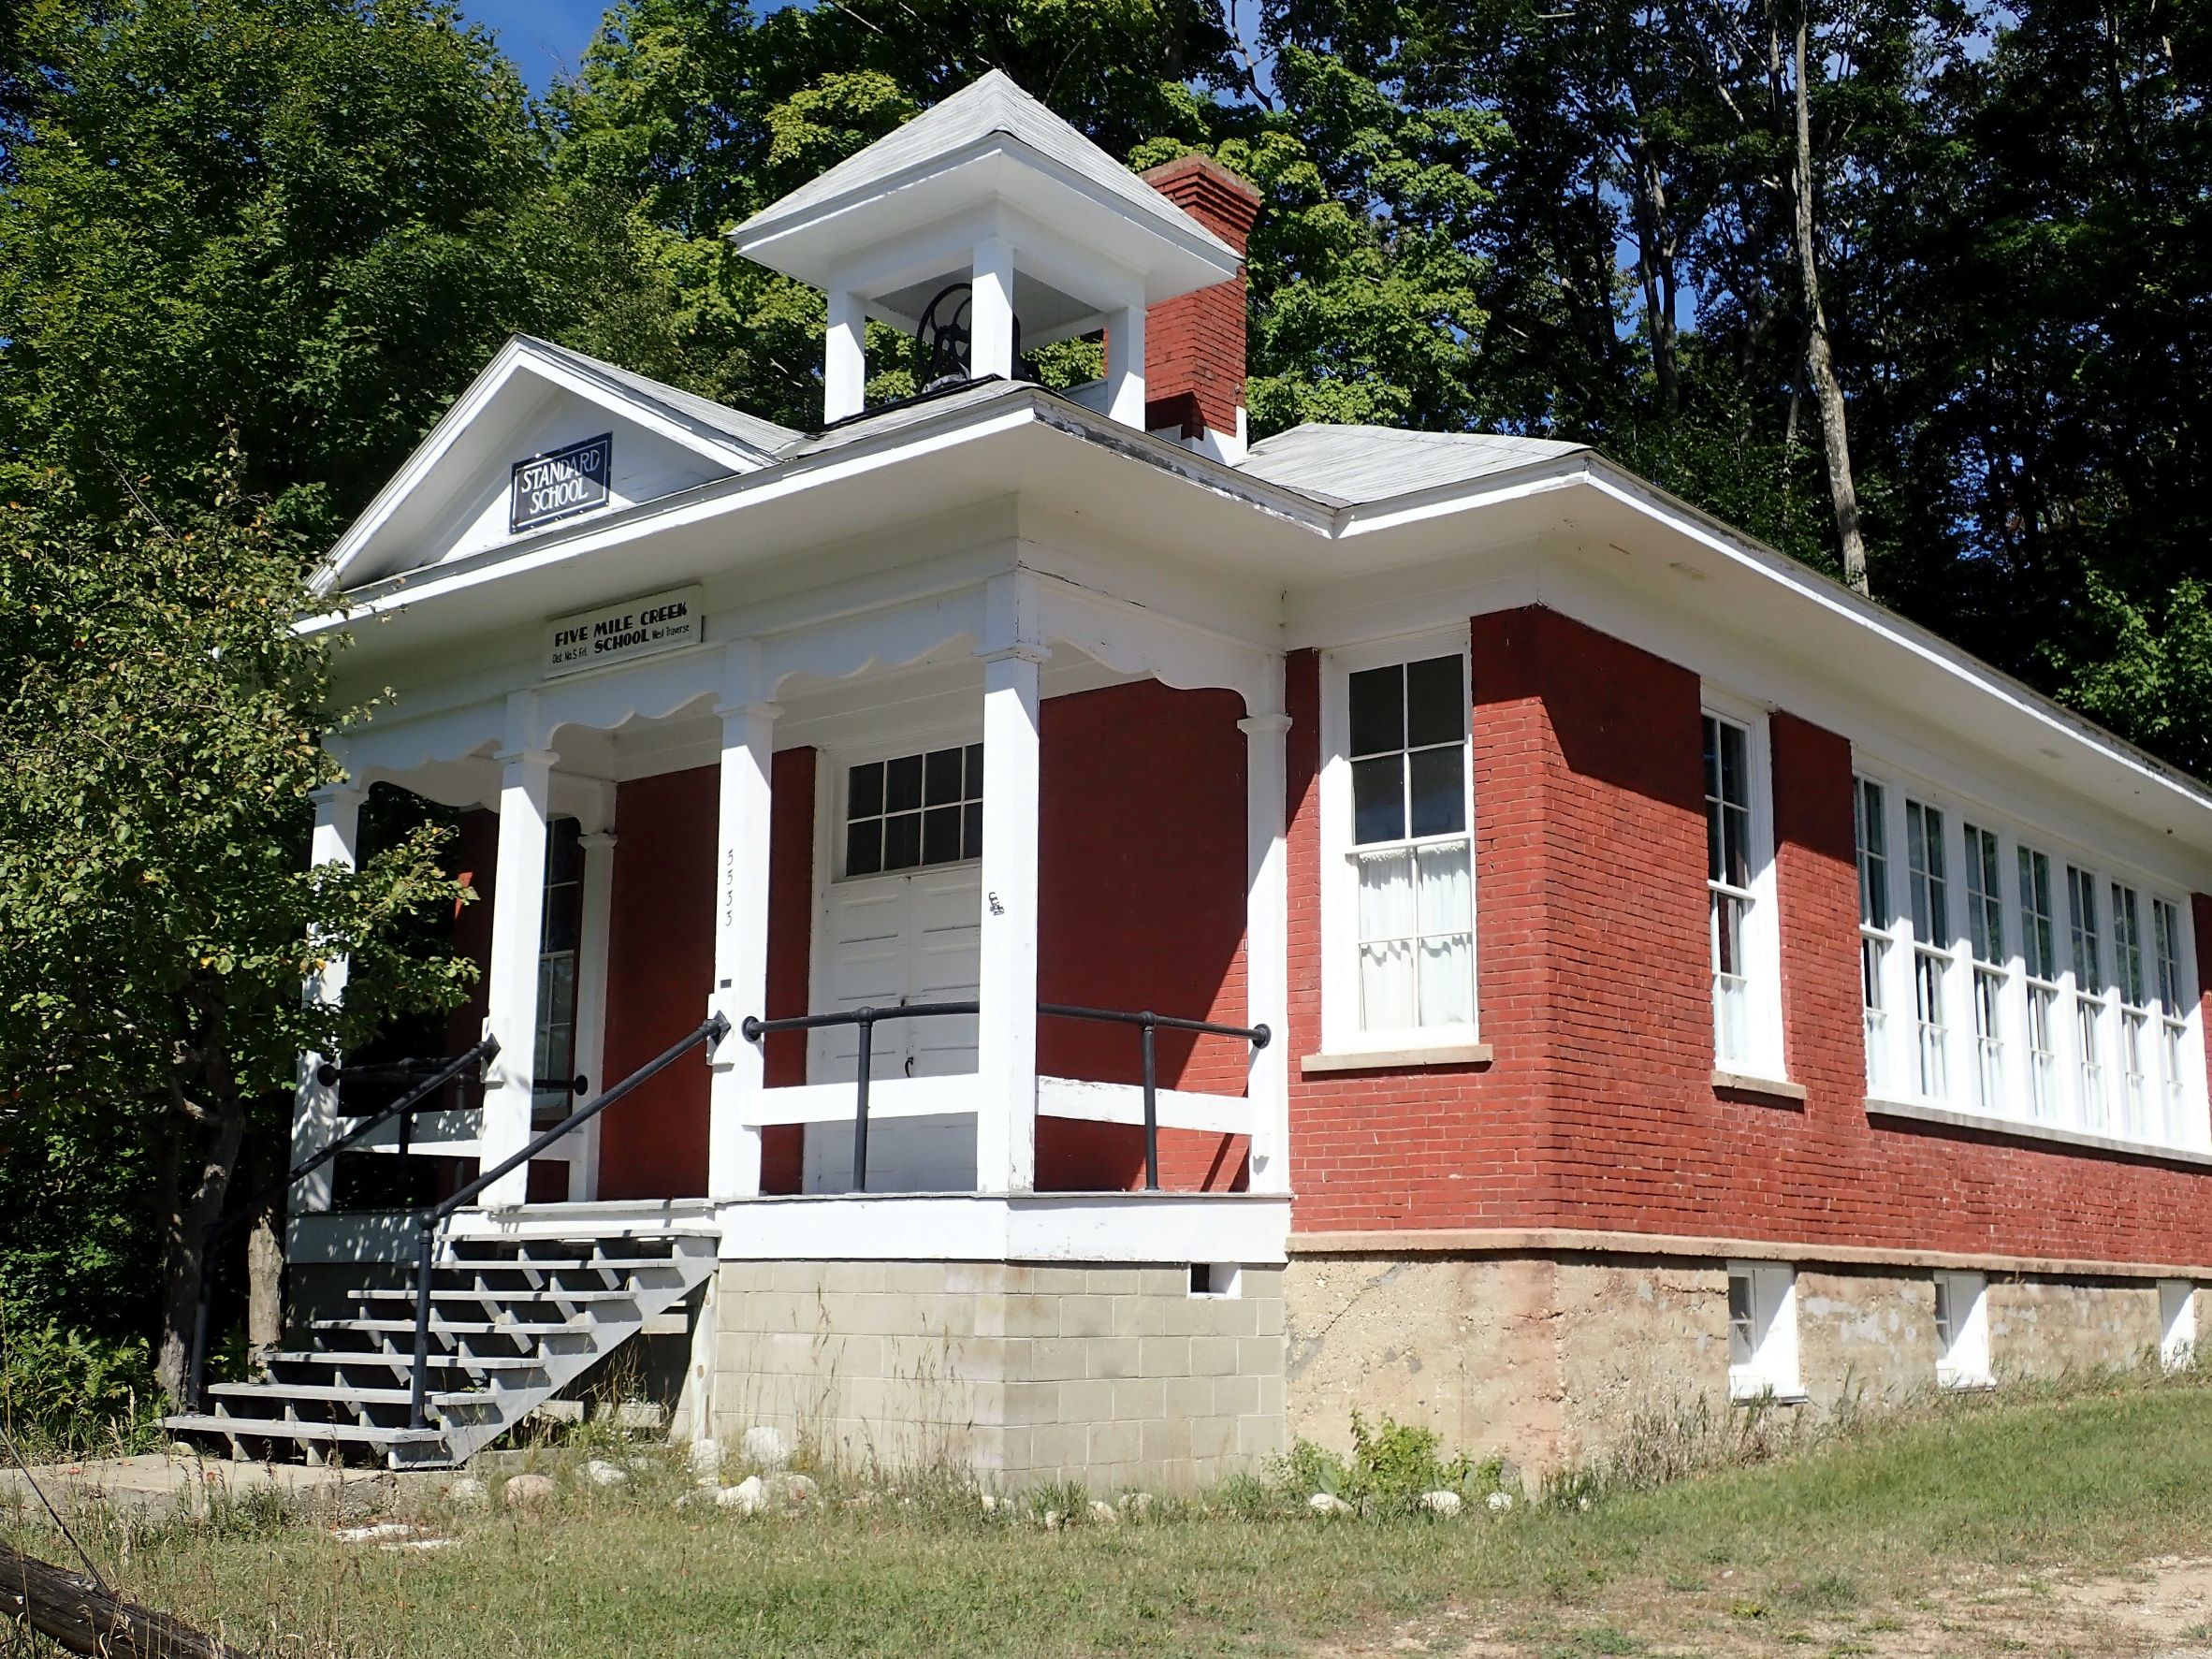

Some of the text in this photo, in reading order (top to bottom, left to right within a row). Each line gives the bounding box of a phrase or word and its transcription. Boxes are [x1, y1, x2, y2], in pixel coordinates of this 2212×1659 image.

[521, 449, 600, 493] STANDARD
[530, 476, 589, 515] SCHOOL
[554, 602, 688, 647] FIVE MILE CREEK
[594, 628, 649, 654] SCHOOL
[651, 624, 690, 639] West Traverse
